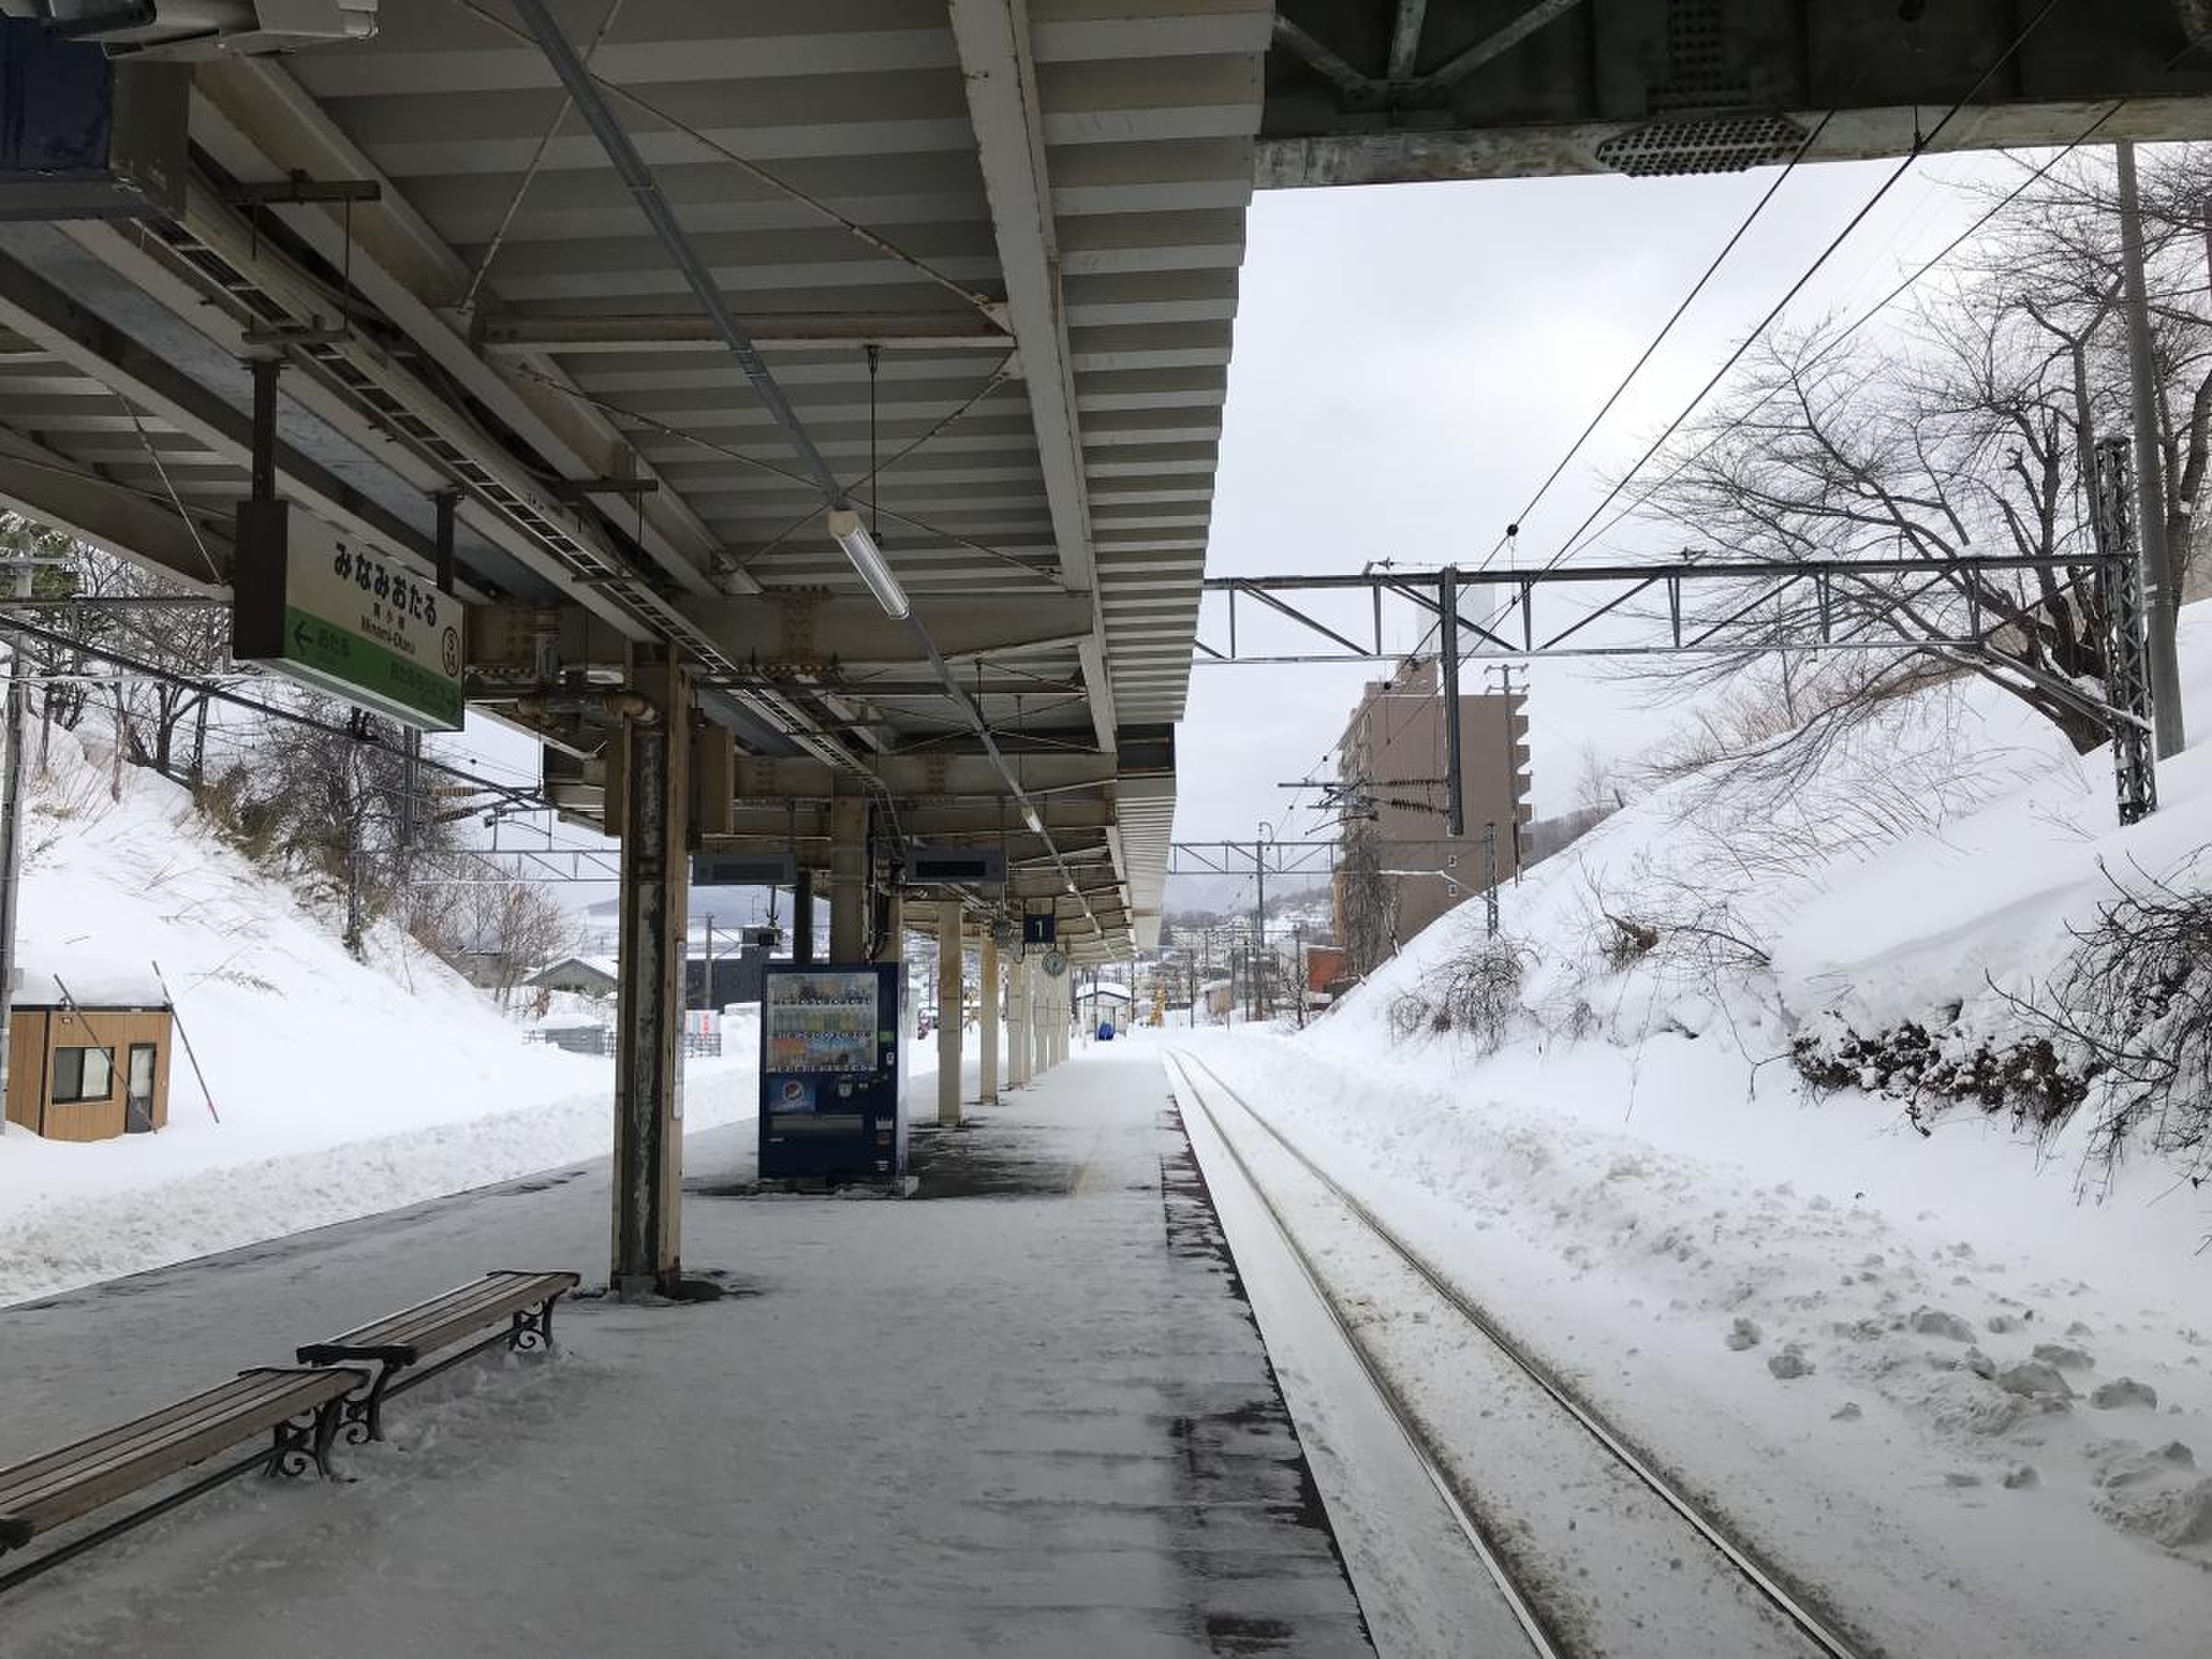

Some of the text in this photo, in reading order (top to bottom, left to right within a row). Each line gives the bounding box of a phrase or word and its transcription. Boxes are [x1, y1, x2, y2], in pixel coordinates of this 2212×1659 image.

[335, 542, 437, 628] みなみおたる
[1035, 920, 1042, 938] 1
